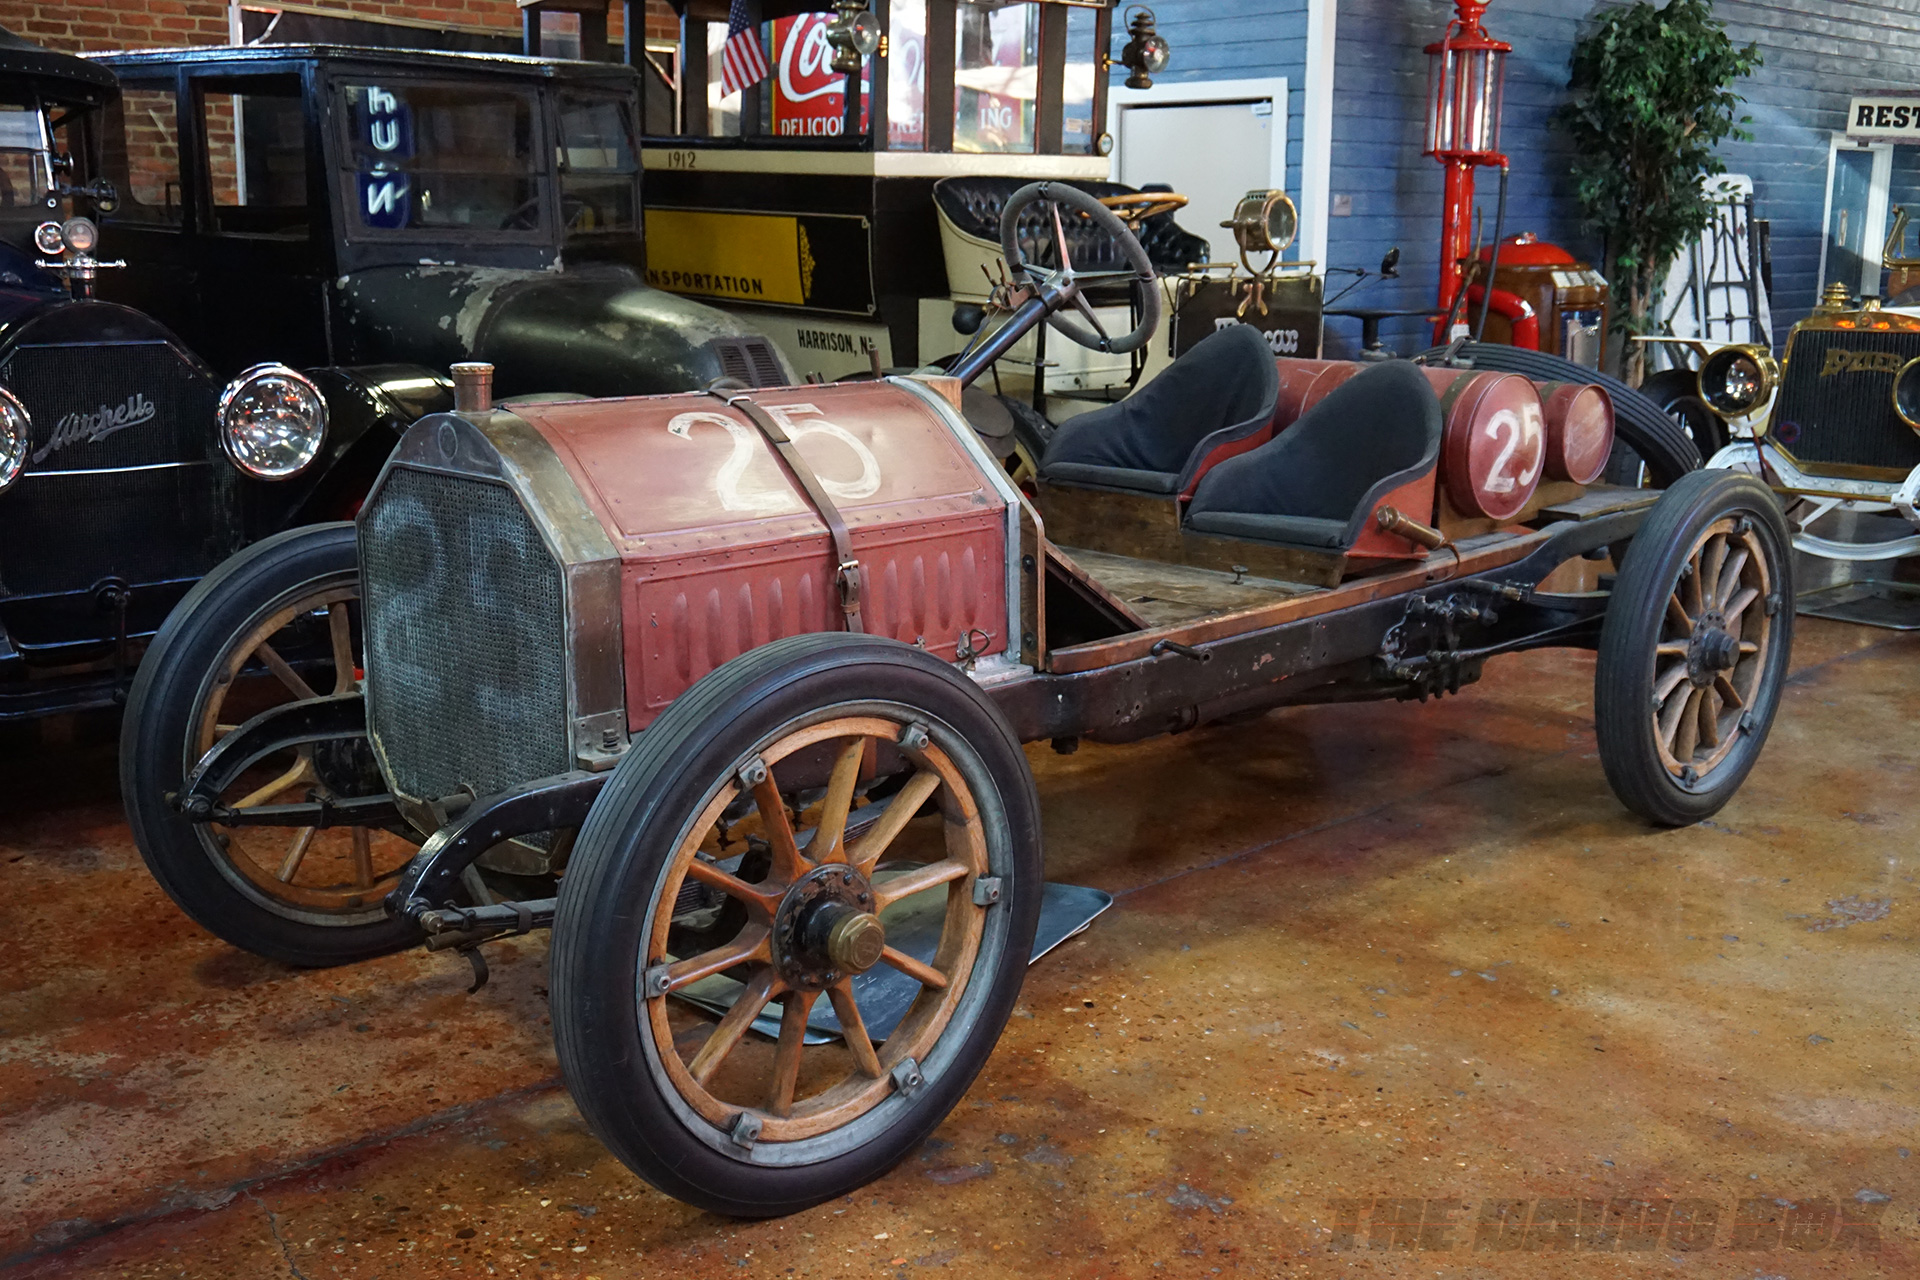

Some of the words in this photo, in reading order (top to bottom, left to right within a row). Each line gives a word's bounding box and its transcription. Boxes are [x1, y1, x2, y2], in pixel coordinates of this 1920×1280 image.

[780, 116, 845, 136] DELICIO
[668, 152, 696, 168] 1912
[797, 329, 857, 357] HARRISON,
[32, 393, 155, 464] Mitchell
[1484, 402, 1543, 493] 25
[668, 403, 881, 511] 25
